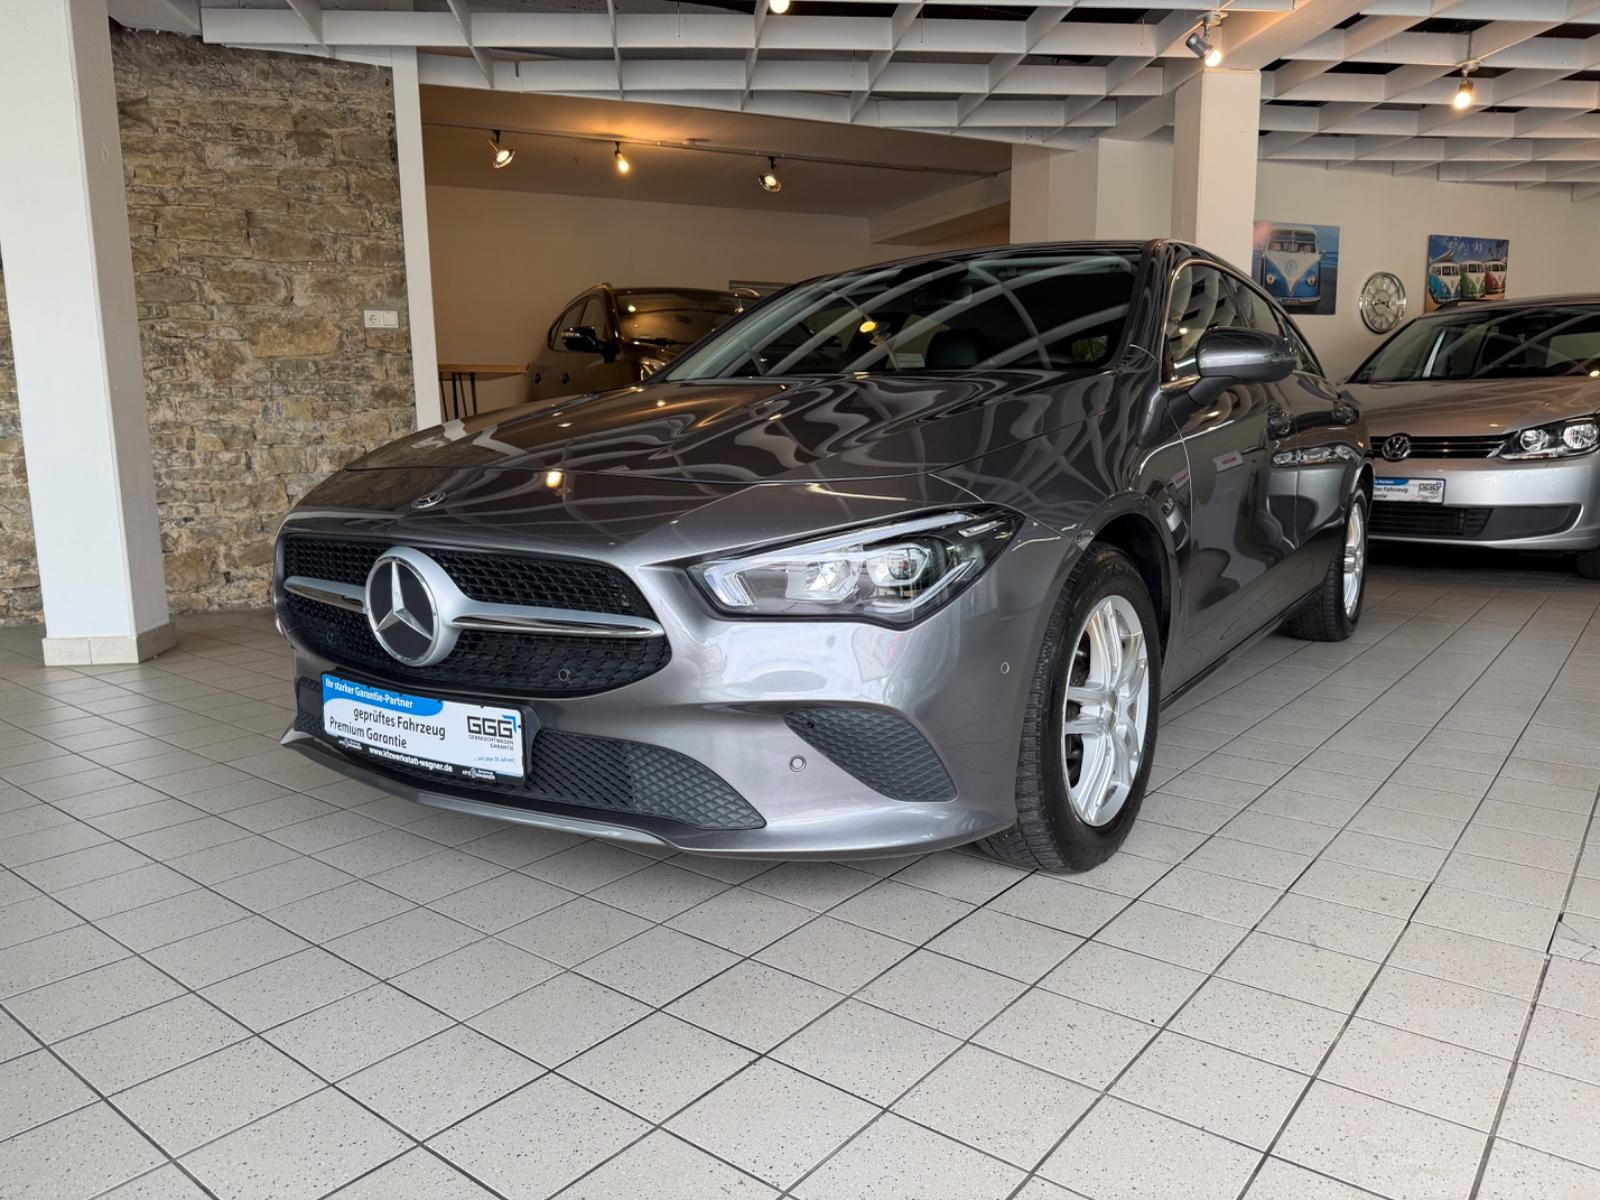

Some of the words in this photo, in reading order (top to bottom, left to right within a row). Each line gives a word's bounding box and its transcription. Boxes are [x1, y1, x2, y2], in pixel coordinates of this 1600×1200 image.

[325, 678, 333, 688] Ihr
[334, 681, 355, 695] starker
[355, 686, 413, 708] Garantie-Partner
[330, 716, 364, 738] Premium
[366, 727, 407, 749] Garantie
[353, 708, 395, 727] geprüftes
[397, 716, 446, 741] Fahrzeug
[467, 715, 513, 739] GGG
